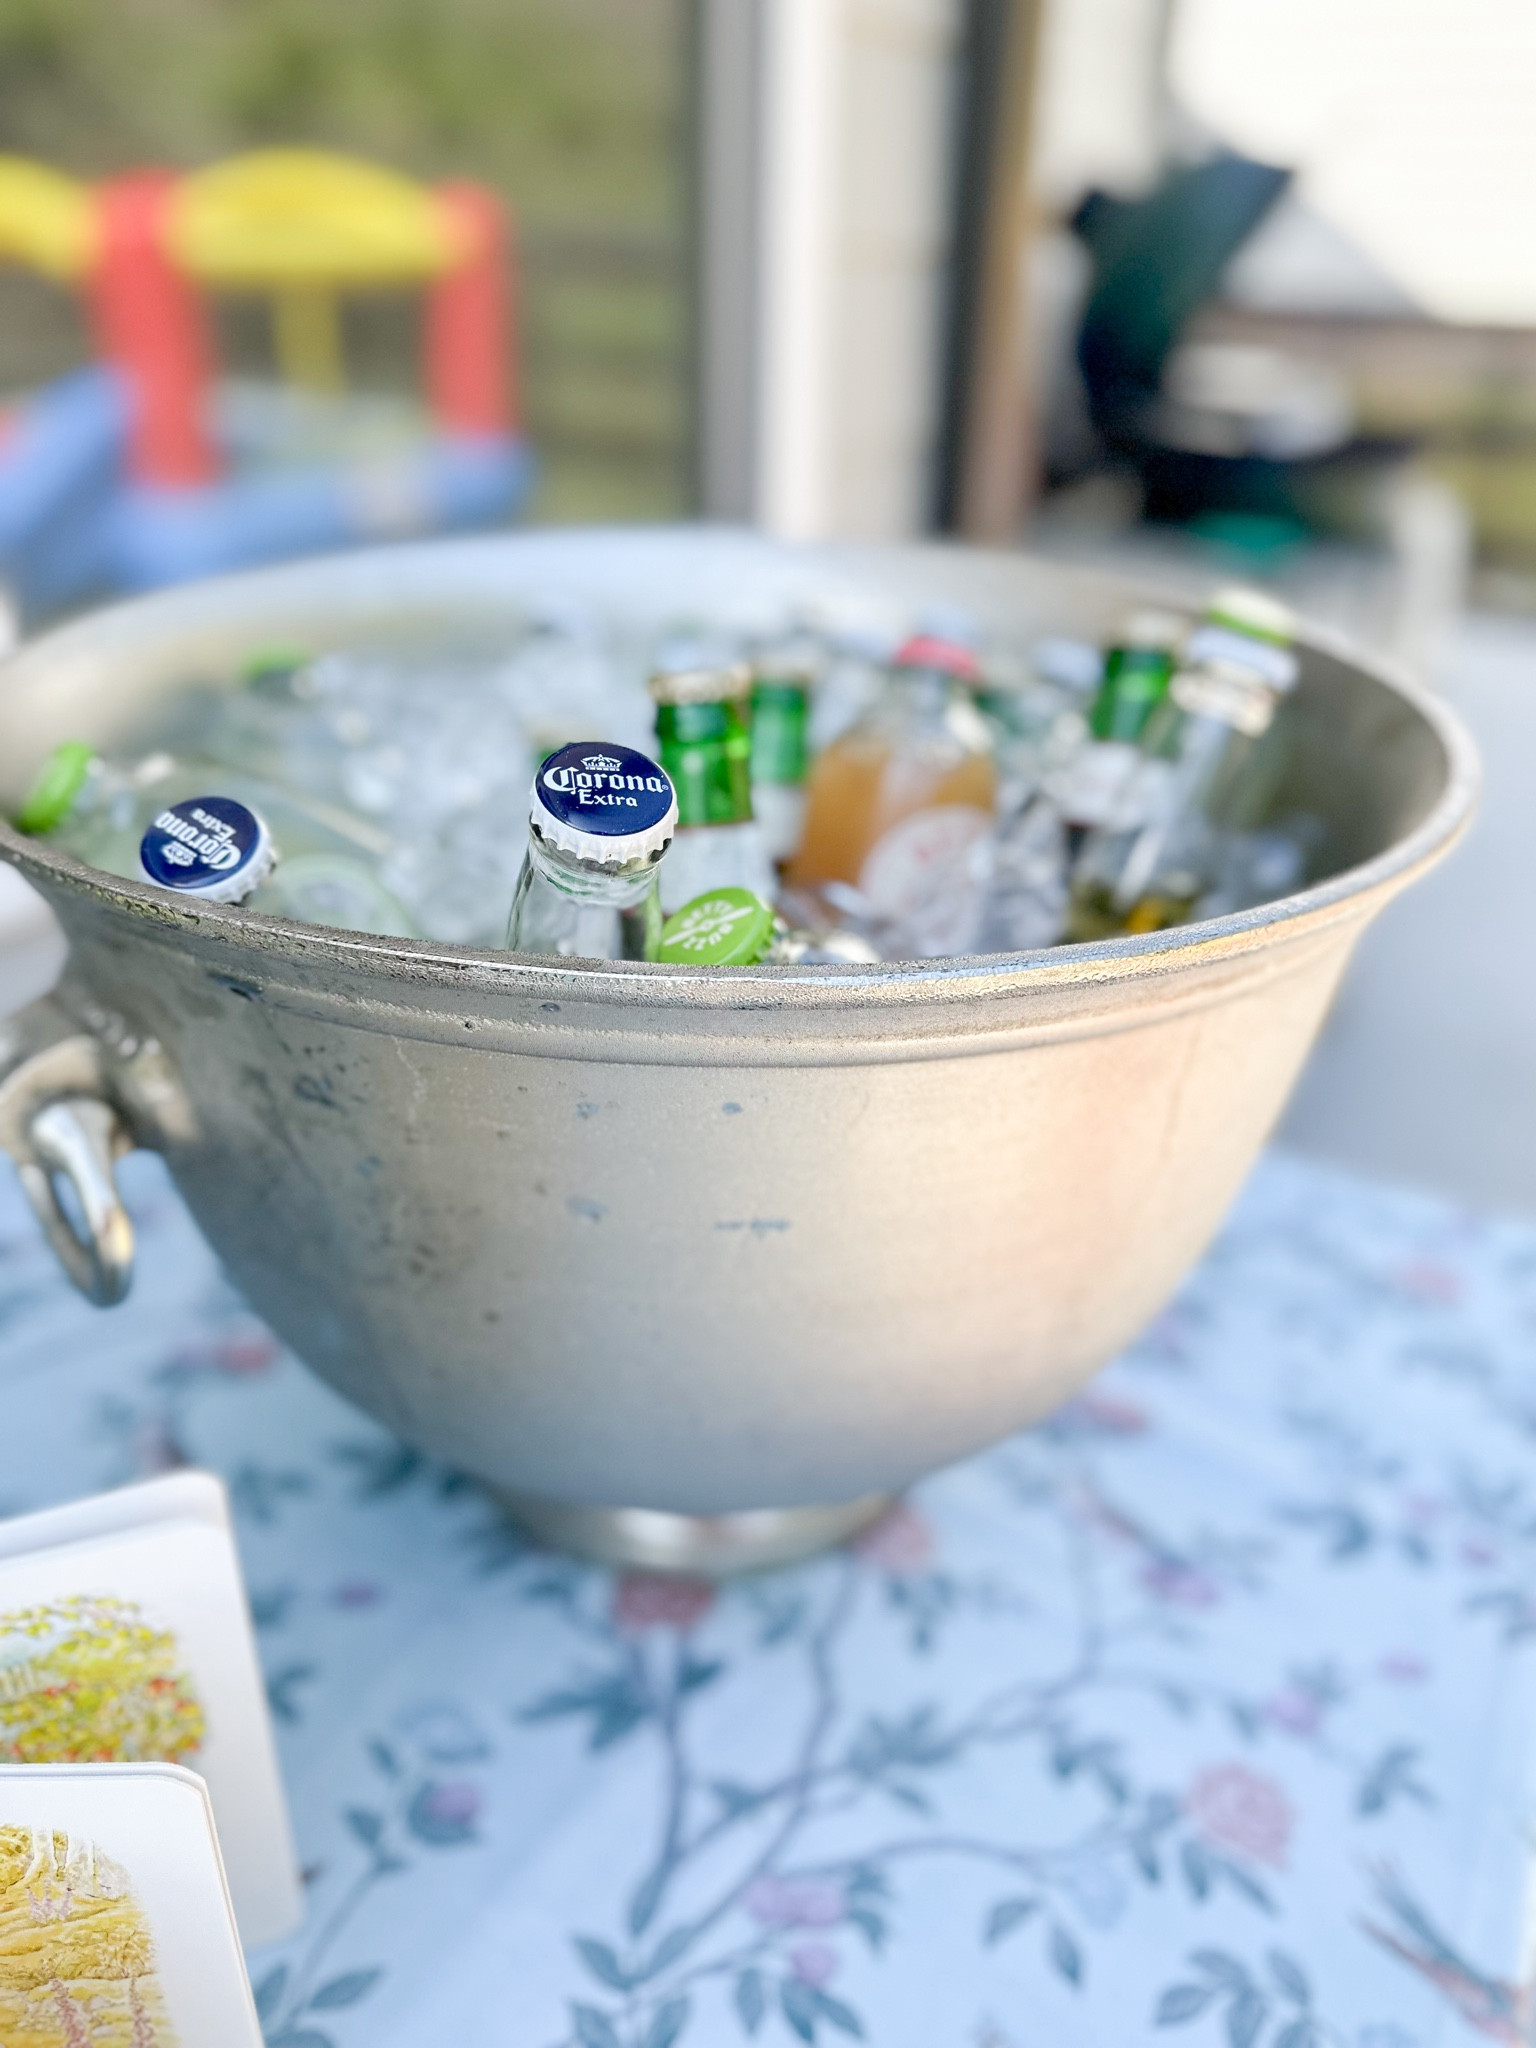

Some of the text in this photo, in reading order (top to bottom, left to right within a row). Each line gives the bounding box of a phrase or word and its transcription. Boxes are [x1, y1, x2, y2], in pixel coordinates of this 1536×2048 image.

[543, 766, 665, 795] Corona
[577, 788, 638, 807] Extra
[154, 811, 242, 870] Corona
[191, 807, 237, 842] Extra
